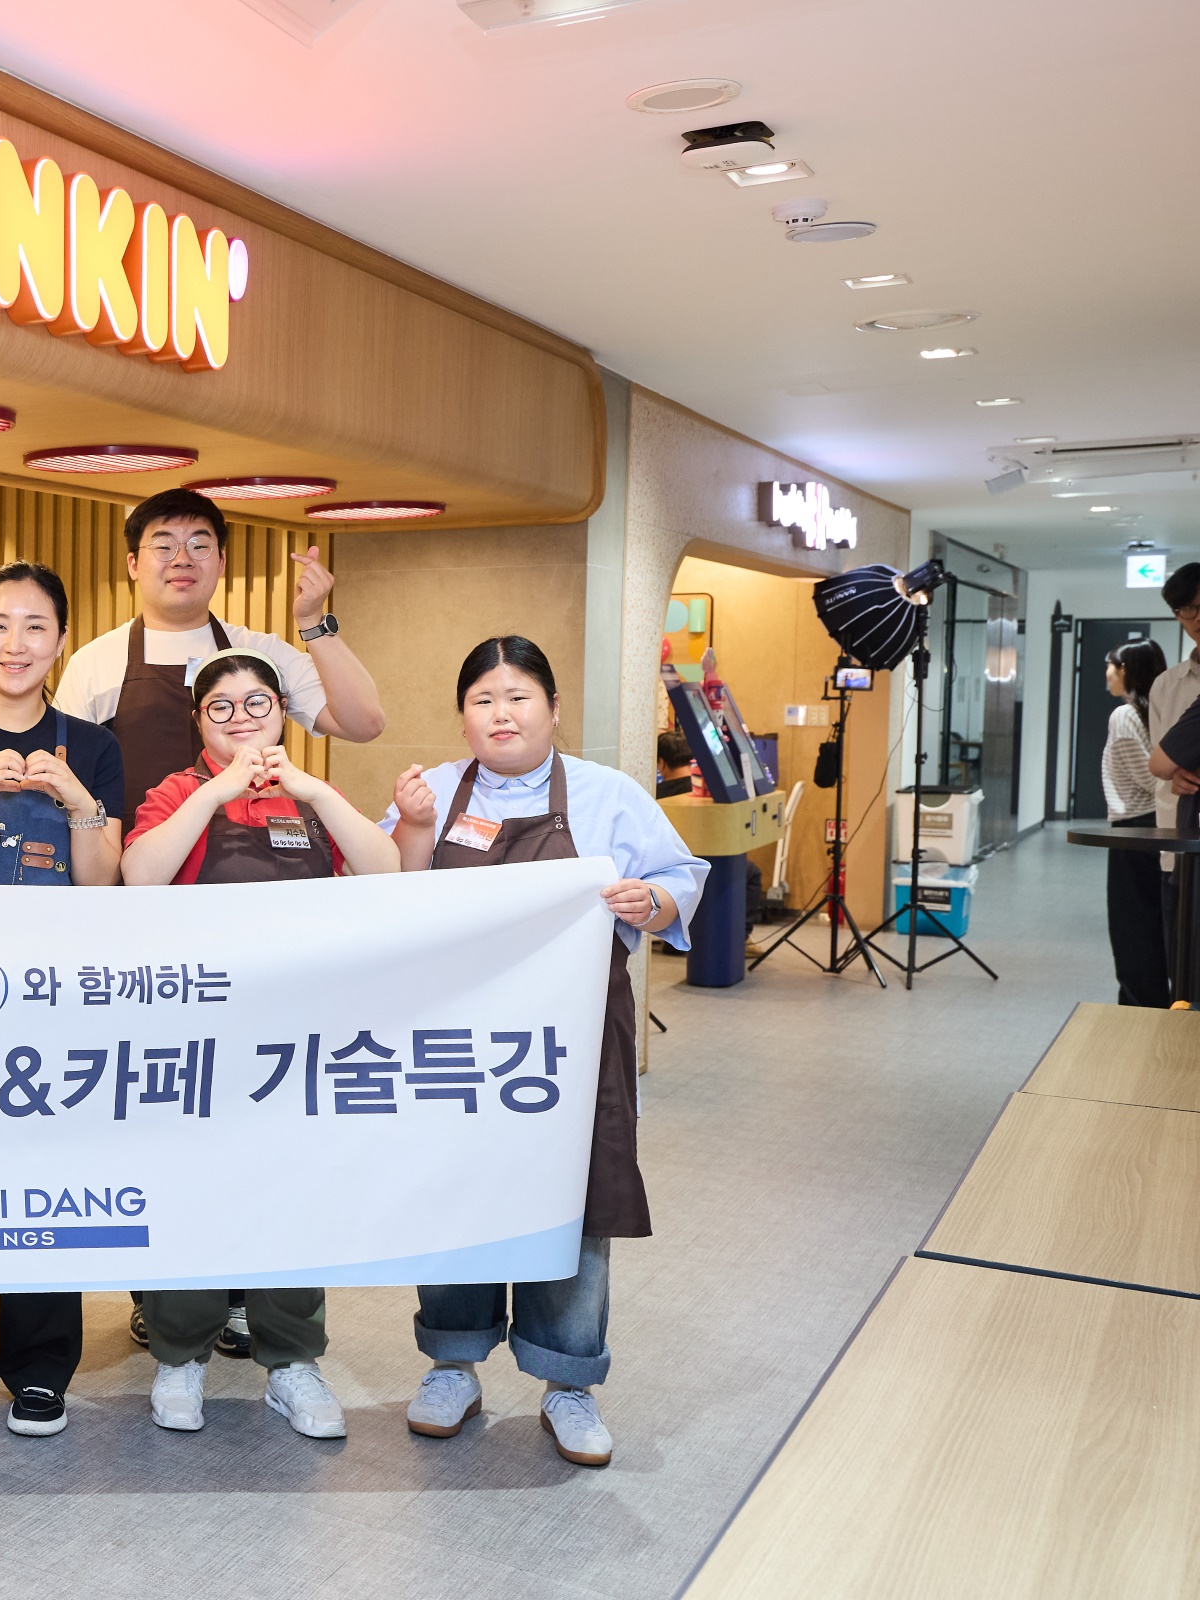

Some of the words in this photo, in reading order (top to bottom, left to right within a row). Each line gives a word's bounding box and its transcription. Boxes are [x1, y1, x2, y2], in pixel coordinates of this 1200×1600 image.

[23, 966, 62, 1006] 와
[78, 963, 232, 1006] 함께하는
[248, 1025, 567, 1116] 기술특강
[24, 1186, 147, 1218] DANG
